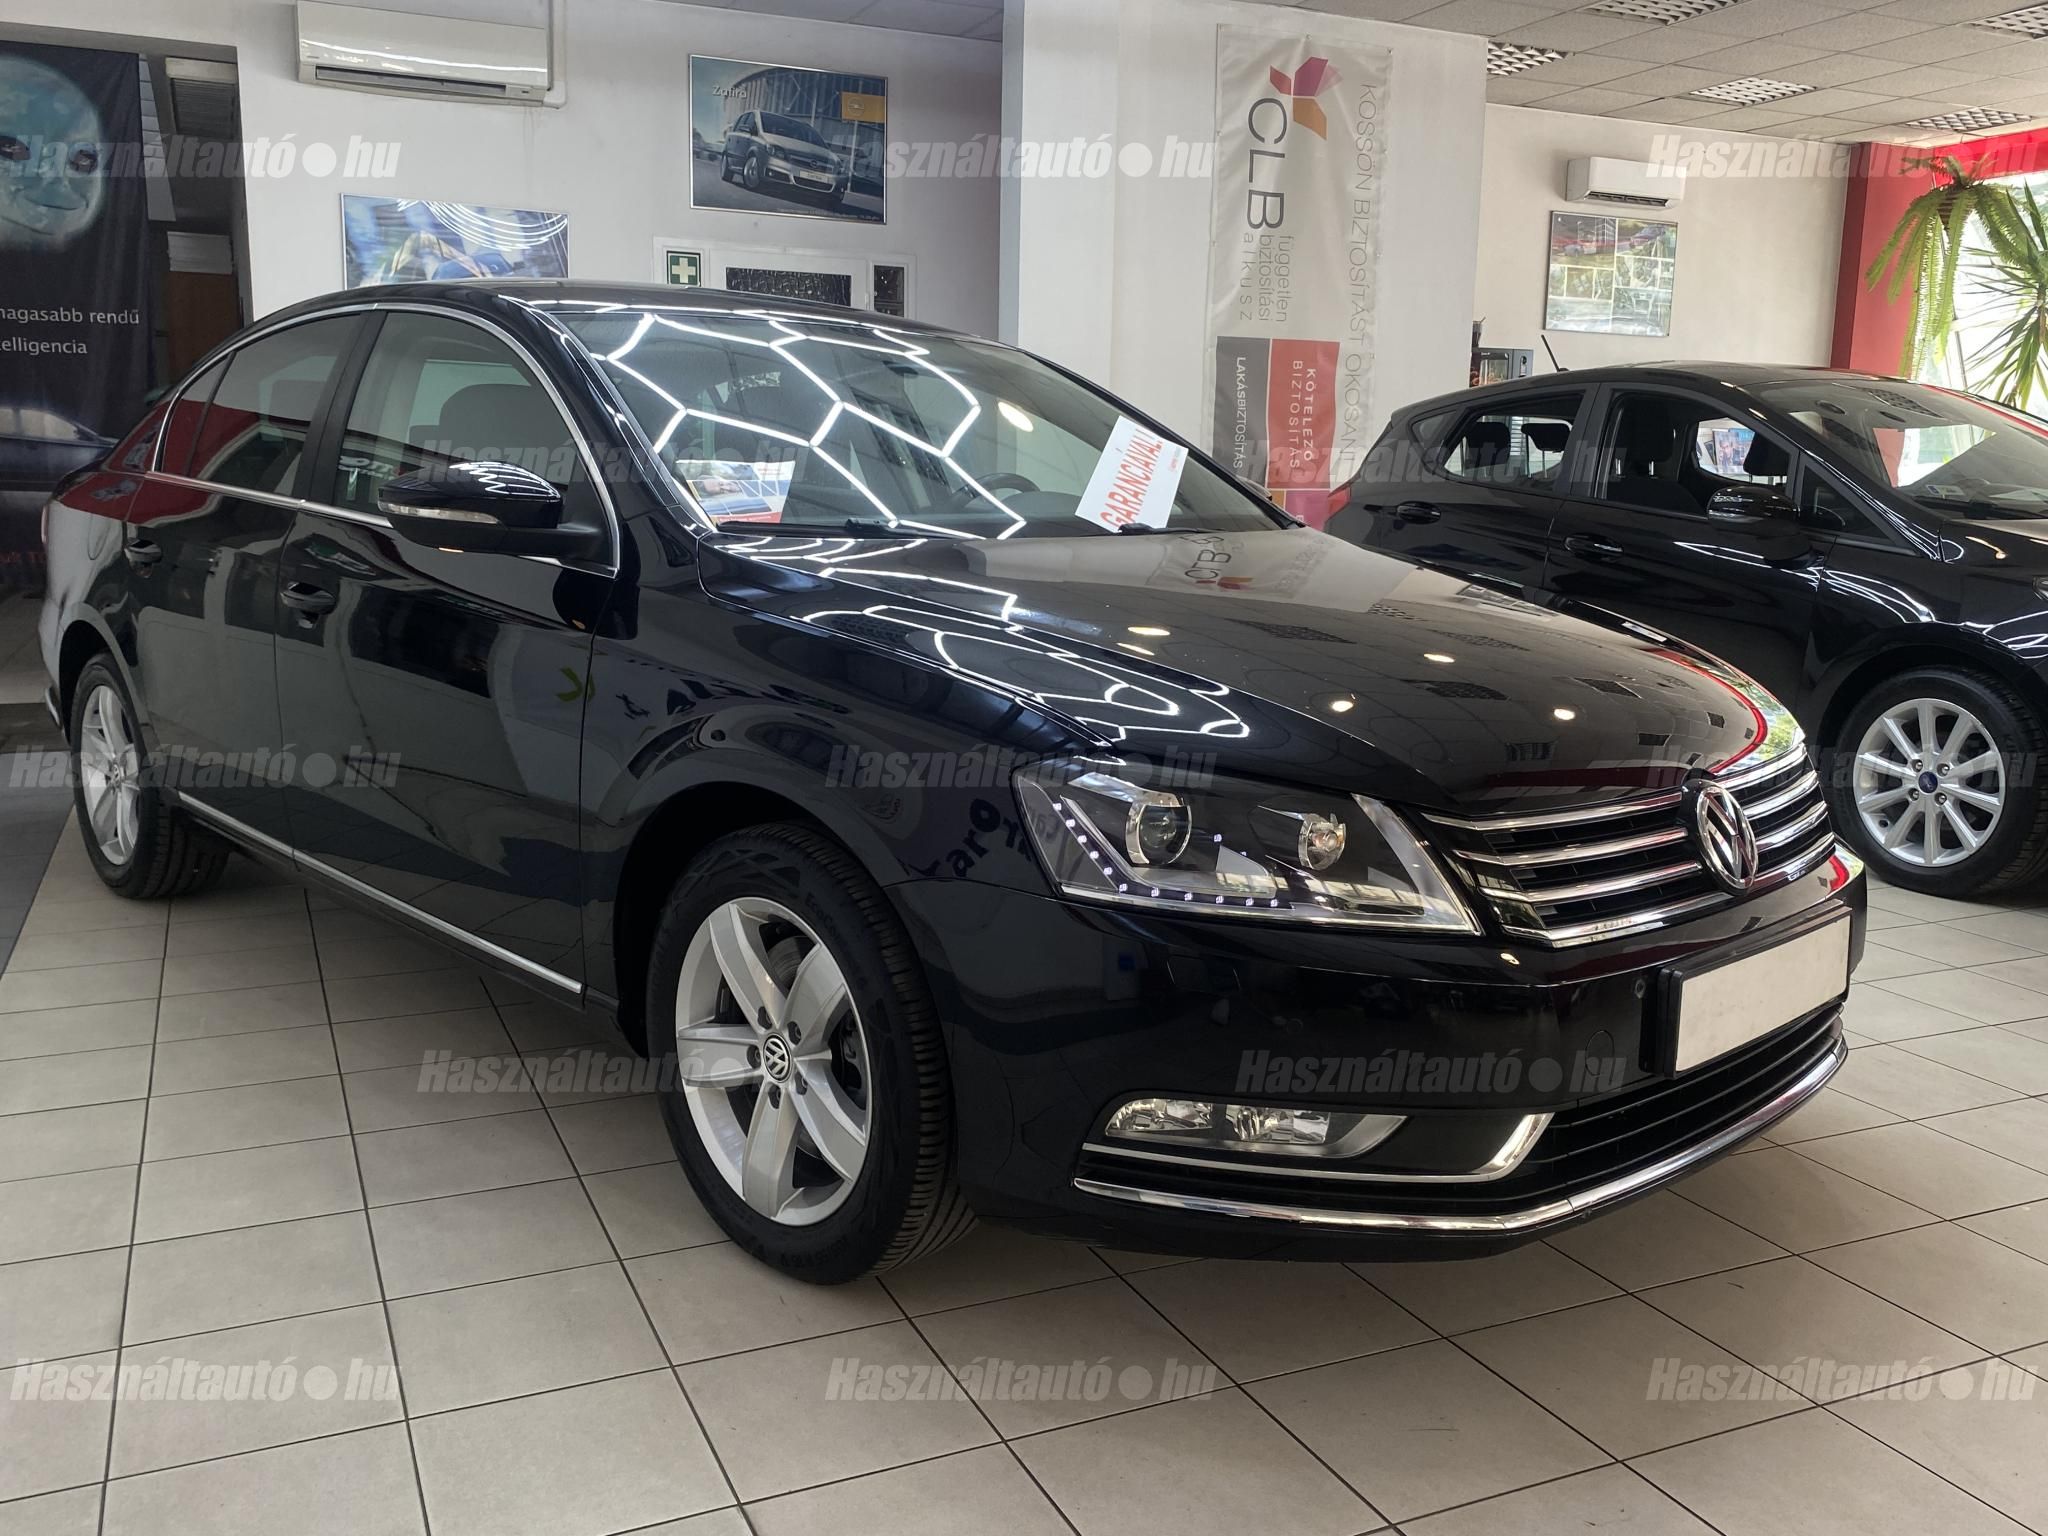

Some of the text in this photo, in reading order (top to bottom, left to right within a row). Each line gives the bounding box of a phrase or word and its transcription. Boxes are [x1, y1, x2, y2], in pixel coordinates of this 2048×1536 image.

[1248, 97, 1288, 230] CLB
[1258, 234, 1276, 321] biztosítási
[1273, 235, 1295, 322] független
[0, 336, 88, 356] elligencia
